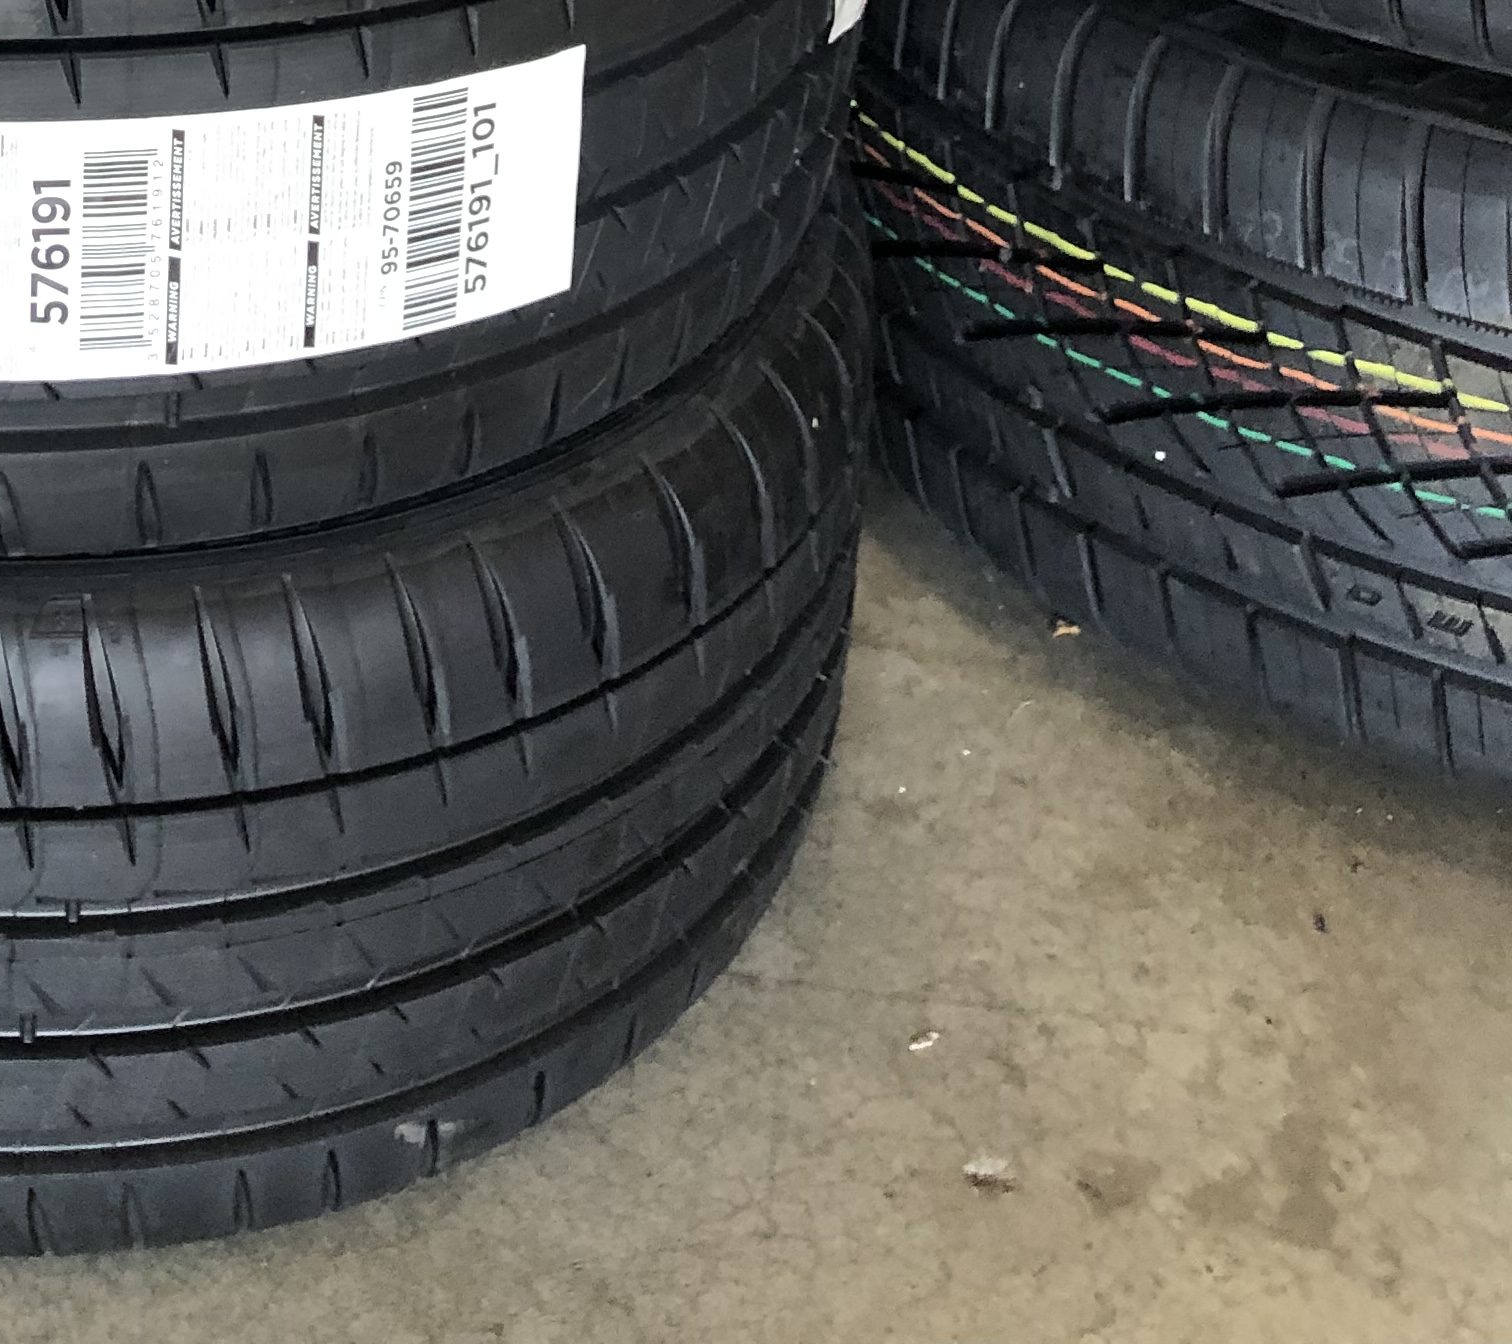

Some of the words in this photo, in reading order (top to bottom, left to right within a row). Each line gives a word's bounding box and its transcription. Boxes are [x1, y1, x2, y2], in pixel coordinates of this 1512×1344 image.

[171, 137, 184, 245] AVERTISSEMENT
[310, 122, 323, 229] AVERTISSEMENT
[380, 160, 402, 275] 95-70659
[464, 101, 499, 295] 576191_101
[29, 178, 71, 325] 576191
[306, 265, 318, 326] WARNING
[167, 281, 180, 343] WARNING
